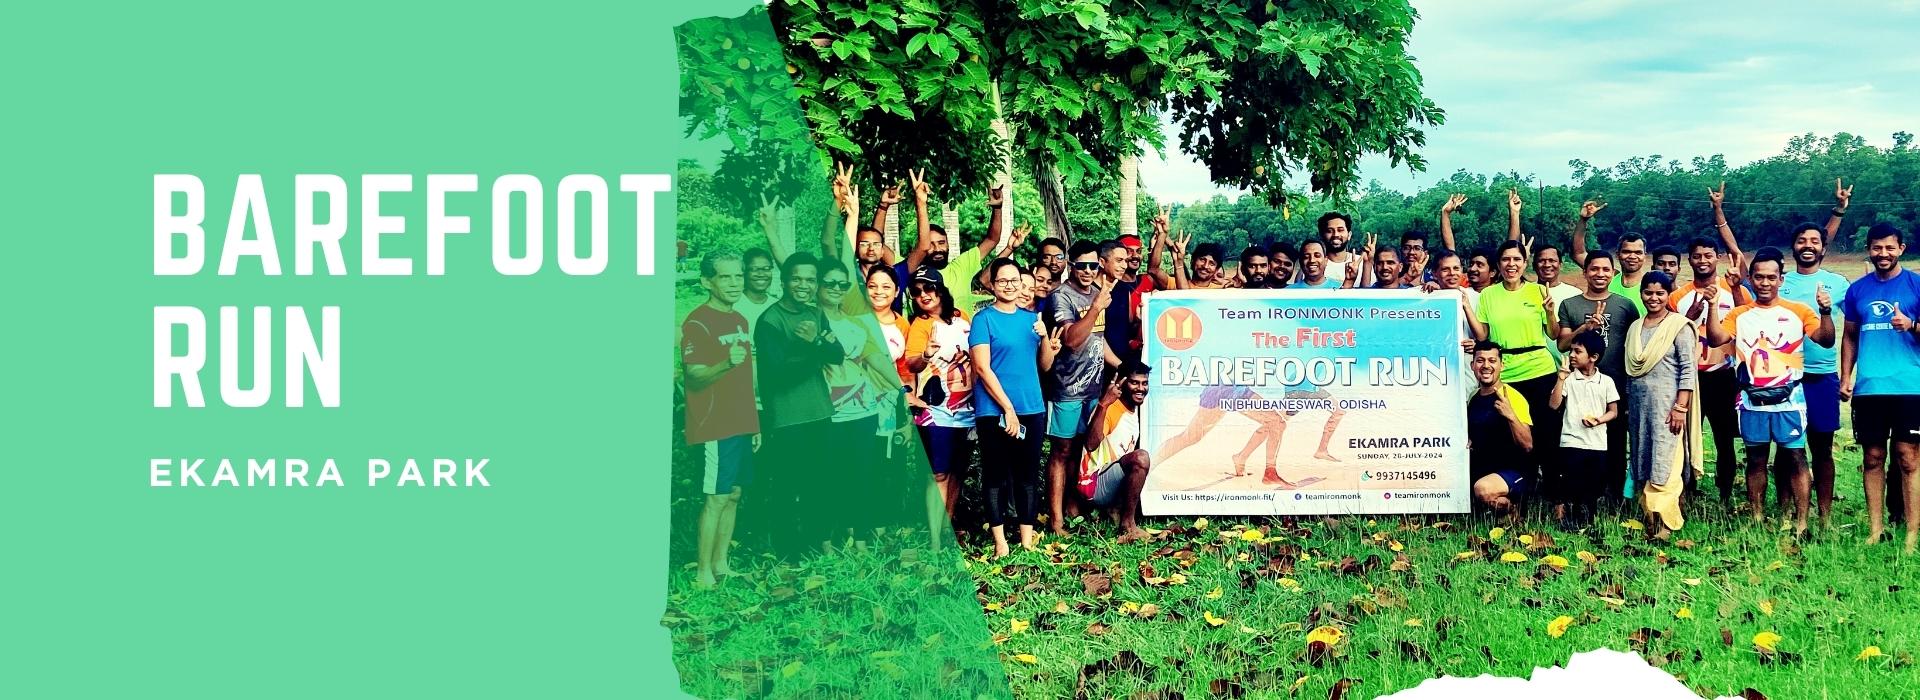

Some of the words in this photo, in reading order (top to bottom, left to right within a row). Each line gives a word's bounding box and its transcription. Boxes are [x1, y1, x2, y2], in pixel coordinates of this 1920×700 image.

[1218, 307, 1262, 319] Team
[1268, 307, 1364, 320] IRONMONK
[1370, 306, 1441, 319] Presents
[1251, 332, 1289, 348] The
[1296, 327, 1356, 348] First
[1160, 356, 1358, 387] BAREFOOT
[1368, 356, 1448, 387] RUN
[1220, 399, 1233, 411] IN
[1236, 399, 1336, 411] BHUBANESWAR,
[1339, 399, 1387, 410] ODISHA
[1348, 438, 1410, 449] EKAMRA
[1413, 436, 1451, 448] PARK
[1376, 470, 1437, 481] 9937145496
[1162, 493, 1179, 501] Visit
[1181, 493, 1193, 501] Us:
[1195, 492, 1276, 502] https://ironmonk.fit/
[1305, 492, 1362, 500] teamironmonk
[1394, 491, 1451, 499] teamironmonk
